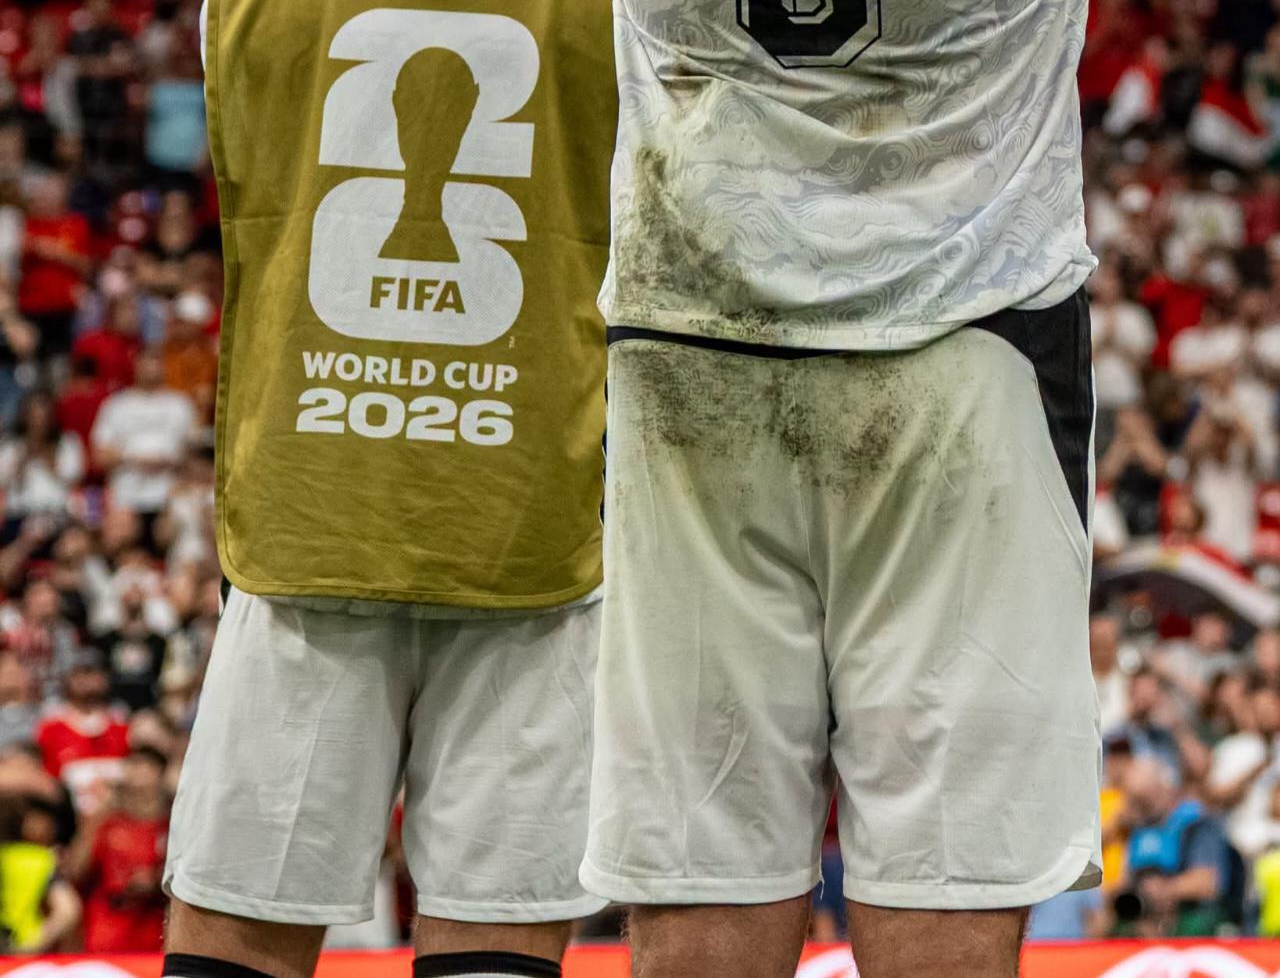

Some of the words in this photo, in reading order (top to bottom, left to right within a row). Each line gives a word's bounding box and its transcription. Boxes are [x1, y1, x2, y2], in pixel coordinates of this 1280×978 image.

[369, 275, 466, 314] FIFA
[302, 351, 436, 386] WORLD
[443, 361, 518, 392] CUP
[295, 386, 514, 447] 2026
